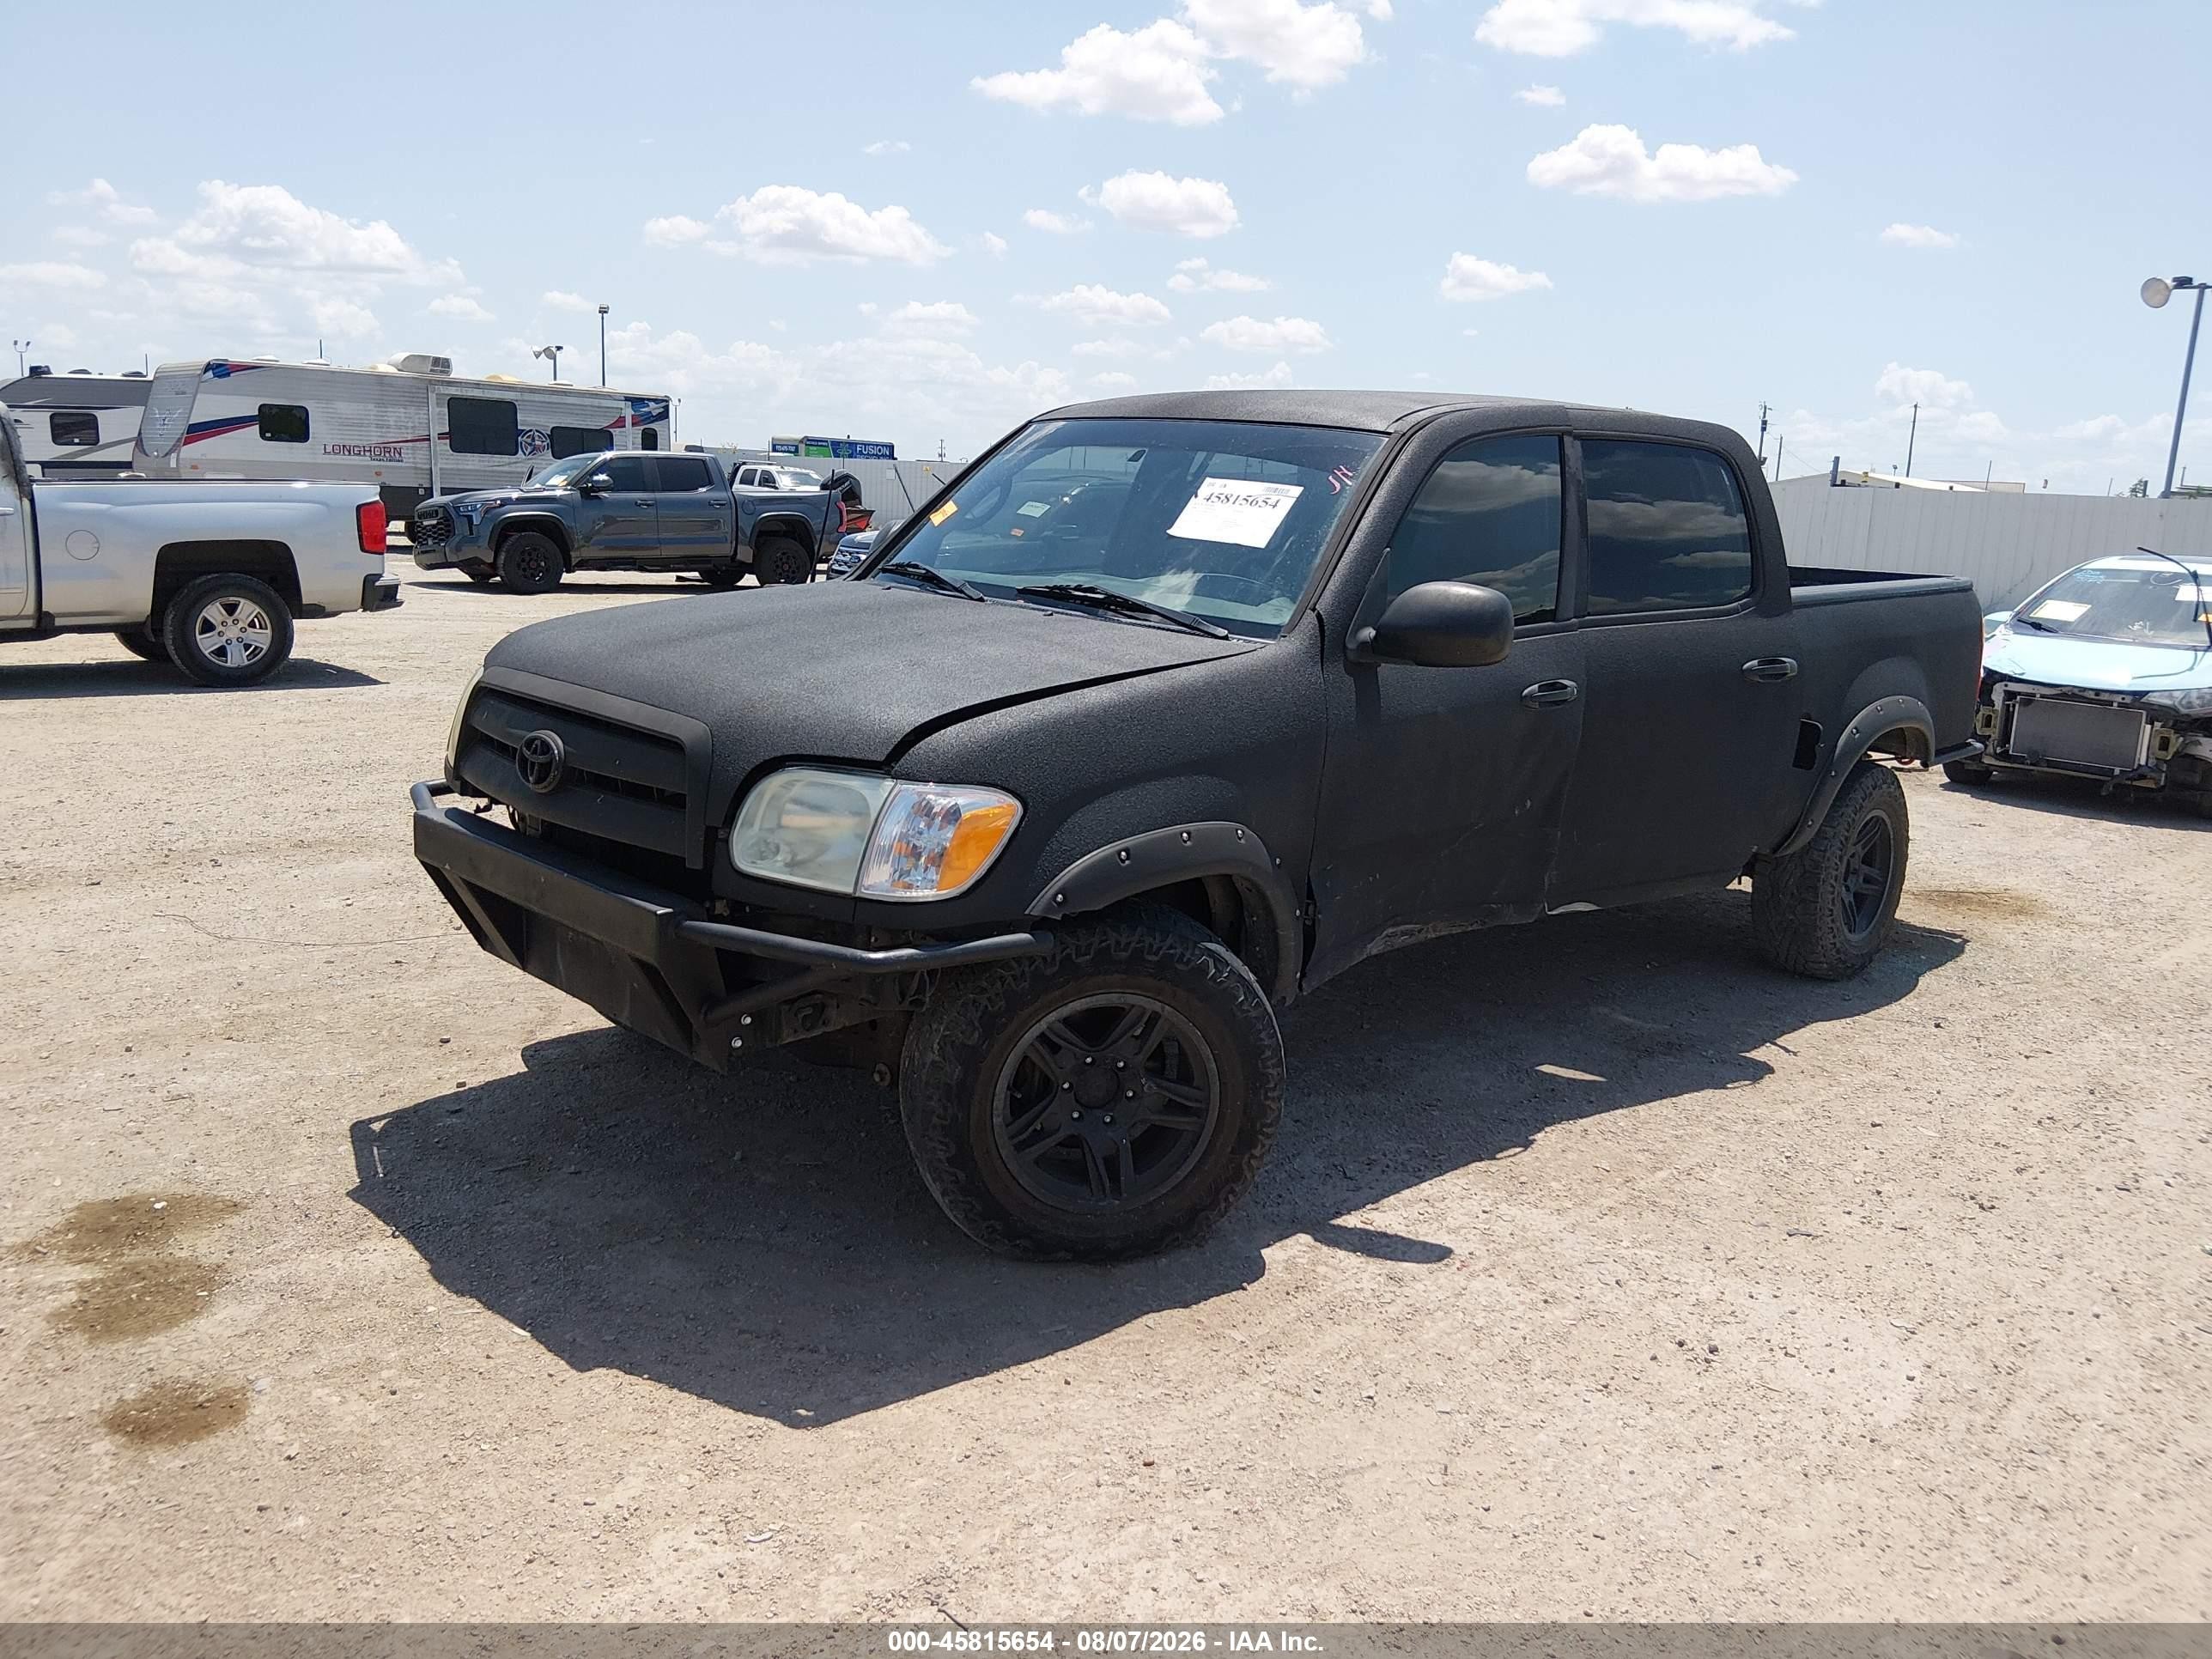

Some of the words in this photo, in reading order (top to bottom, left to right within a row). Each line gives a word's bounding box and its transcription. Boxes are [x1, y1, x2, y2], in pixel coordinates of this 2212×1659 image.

[323, 443, 404, 458] LONGHORN
[856, 444, 890, 456] FUSION
[1202, 491, 1281, 509] 45815654
